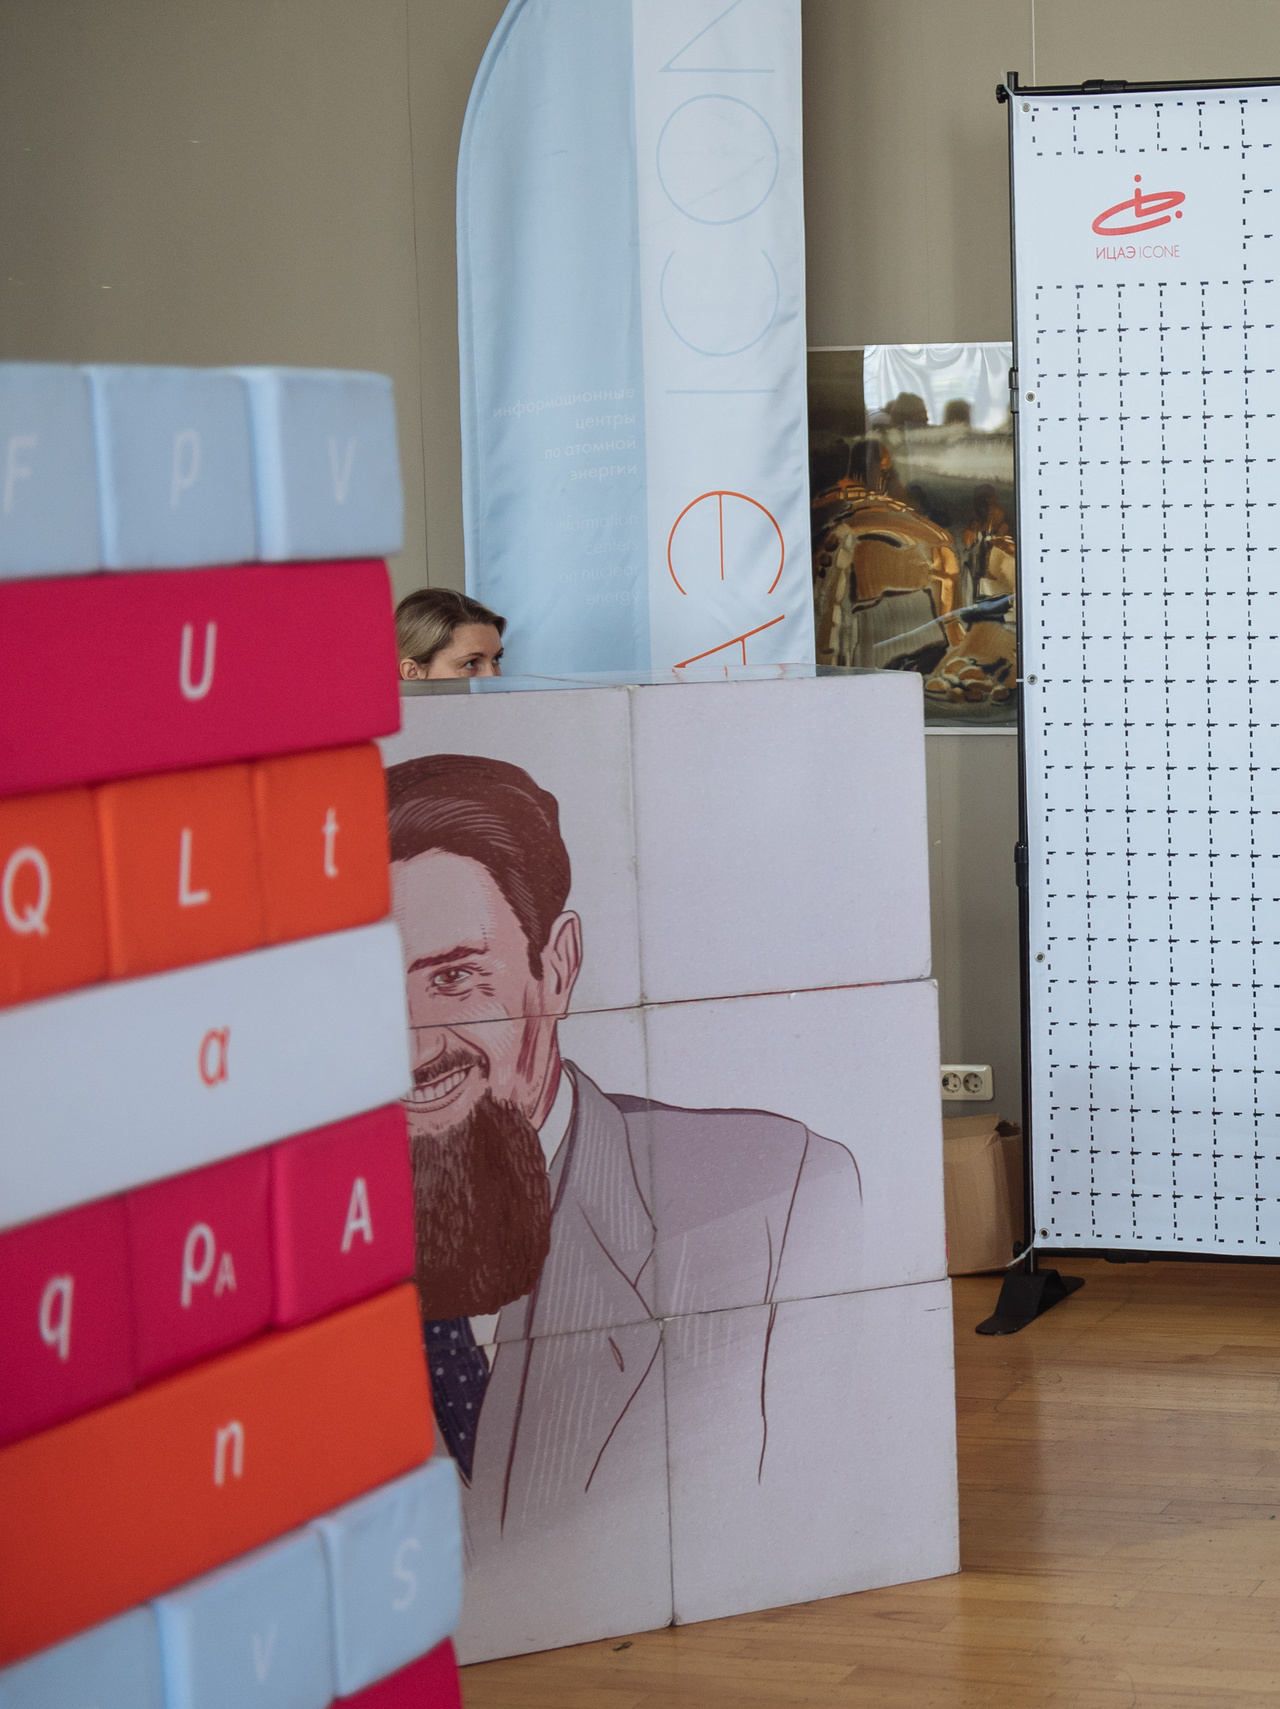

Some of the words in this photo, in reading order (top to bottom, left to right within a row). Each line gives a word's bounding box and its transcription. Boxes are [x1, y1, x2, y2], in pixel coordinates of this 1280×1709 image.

[1096, 246, 1136, 261] ИЦАЭ
[1139, 245, 1180, 258] ICONE
[576, 414, 635, 430] центры
[545, 448, 561, 460] по
[565, 435, 637, 456] атомной
[570, 464, 638, 482] энергии
[179, 621, 217, 701] U
[1, 845, 51, 937] Q
[178, 828, 211, 907] L
[322, 807, 340, 878] t
[340, 1177, 374, 1253] A
[213, 1420, 244, 1487] n
